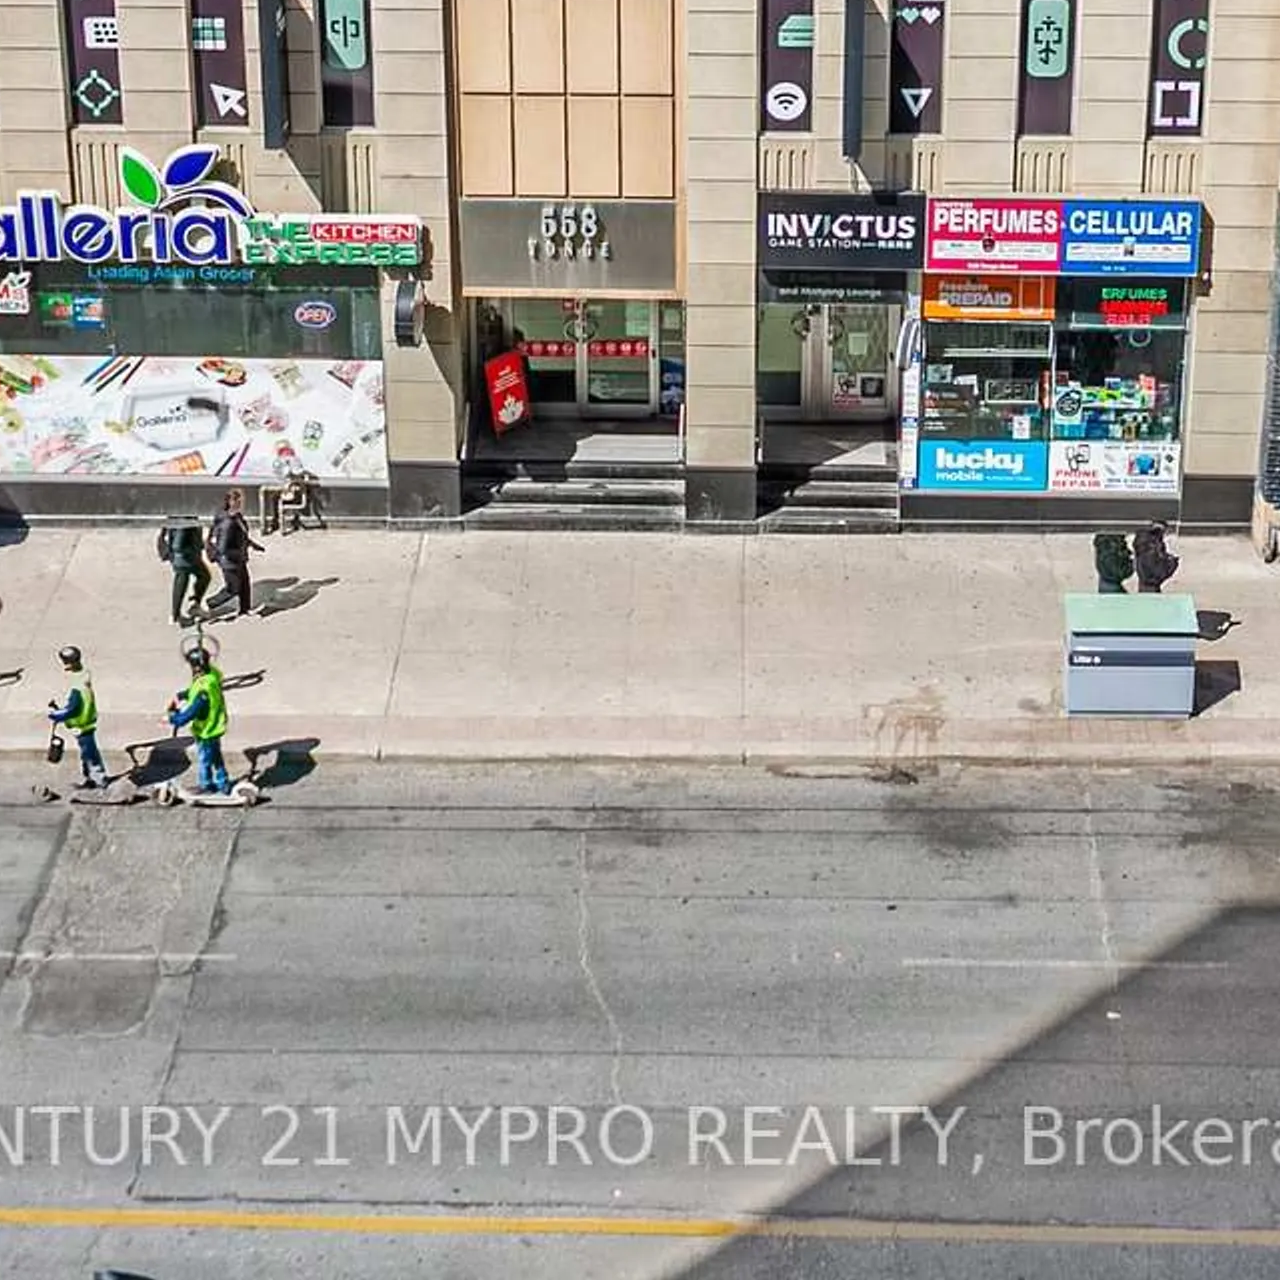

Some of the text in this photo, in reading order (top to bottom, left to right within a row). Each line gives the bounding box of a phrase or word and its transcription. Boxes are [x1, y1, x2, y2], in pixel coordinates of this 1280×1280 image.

[243, 219, 414, 240] THE KITCHEN
[767, 213, 916, 239] INVICTUS
[933, 207, 1058, 234] PERFUMES
[1069, 209, 1193, 236] CELLULAR
[245, 242, 418, 265] EXPRESS
[527, 236, 609, 258] YONGE
[768, 238, 861, 249] GAME STATION
[87, 265, 255, 282] Leading Asian Grocer
[939, 292, 1013, 306] PREPAID
[935, 447, 1024, 475] lucky
[935, 471, 984, 482] mobile
[1055, 470, 1098, 479] PHONE
